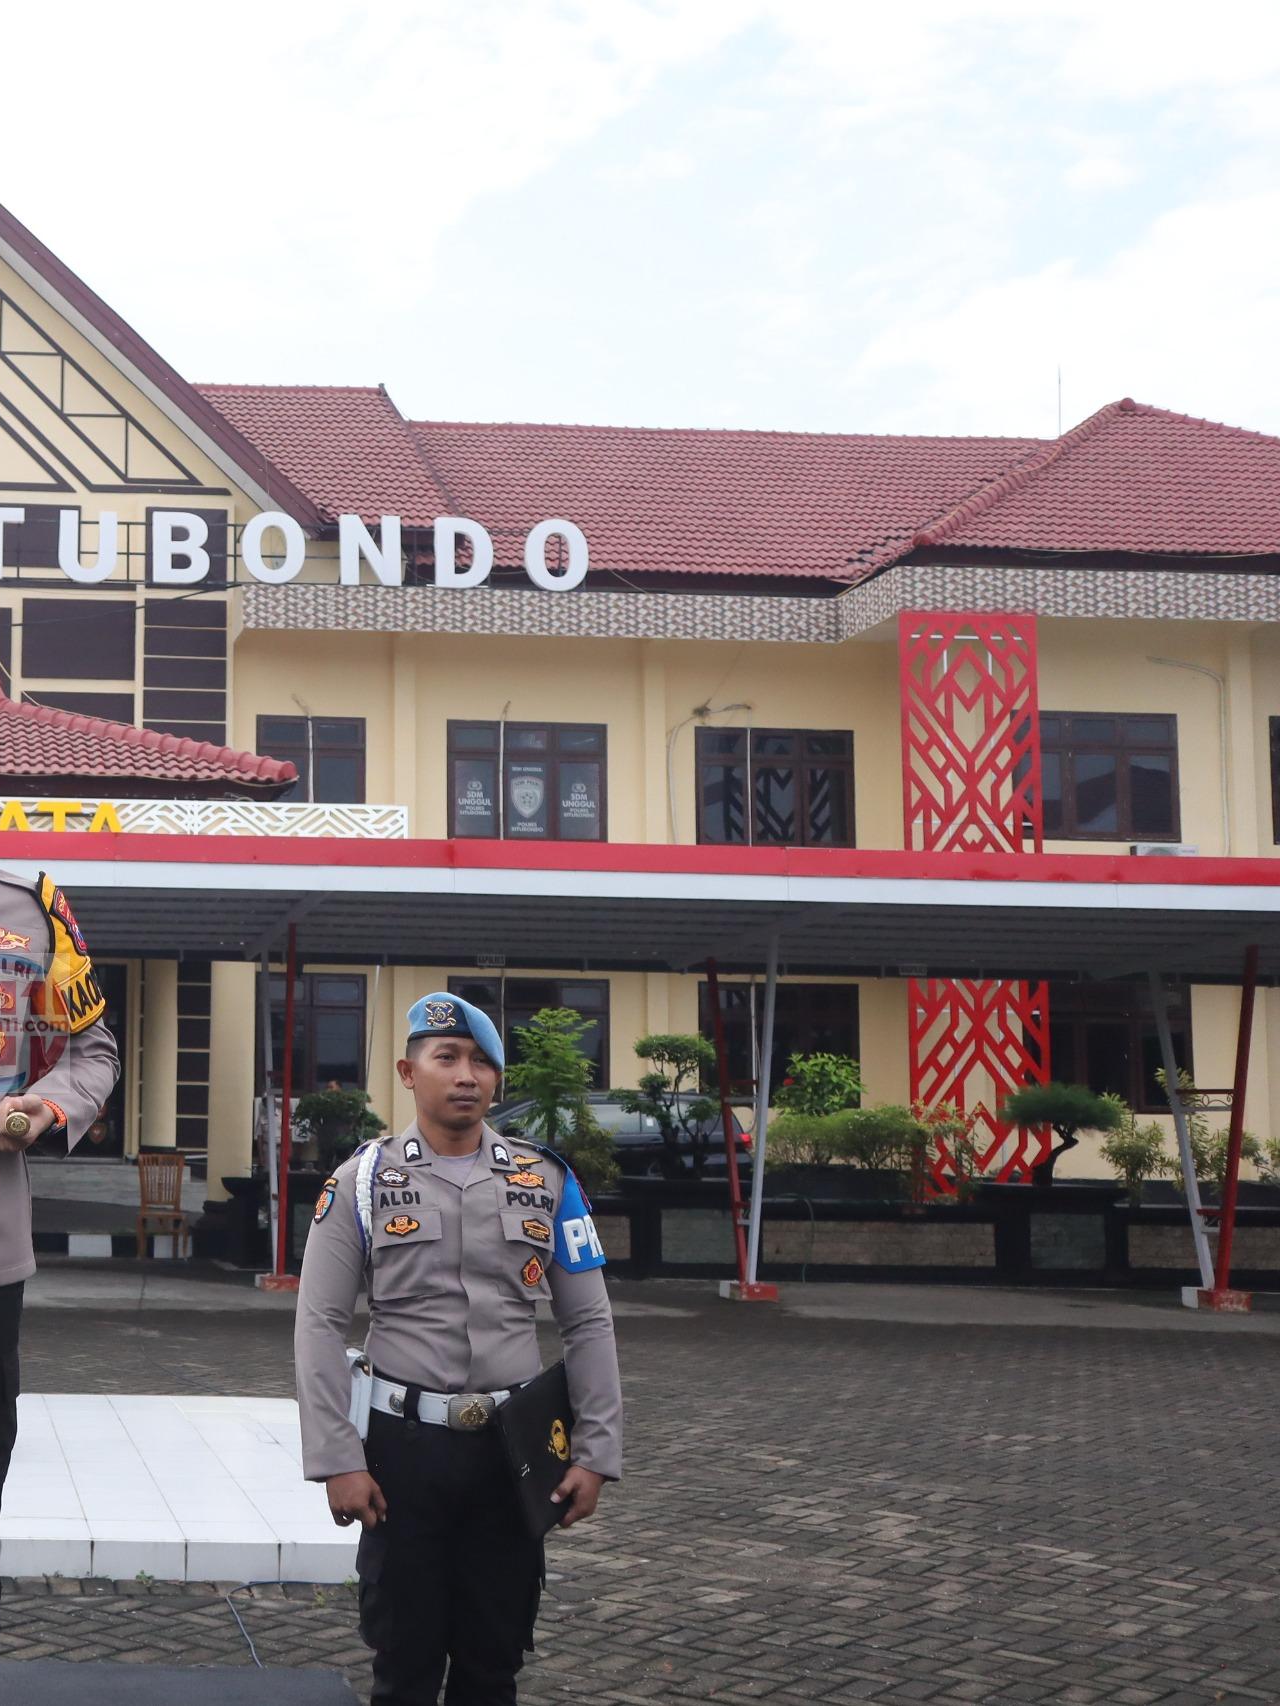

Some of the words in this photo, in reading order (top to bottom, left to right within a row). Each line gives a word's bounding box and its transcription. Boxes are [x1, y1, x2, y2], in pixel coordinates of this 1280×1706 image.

[458, 798, 492, 806] UNGGUL
[562, 800, 596, 808] UNGGUL
[379, 1191, 421, 1208] ALDI
[506, 1191, 553, 1213] POLRI
